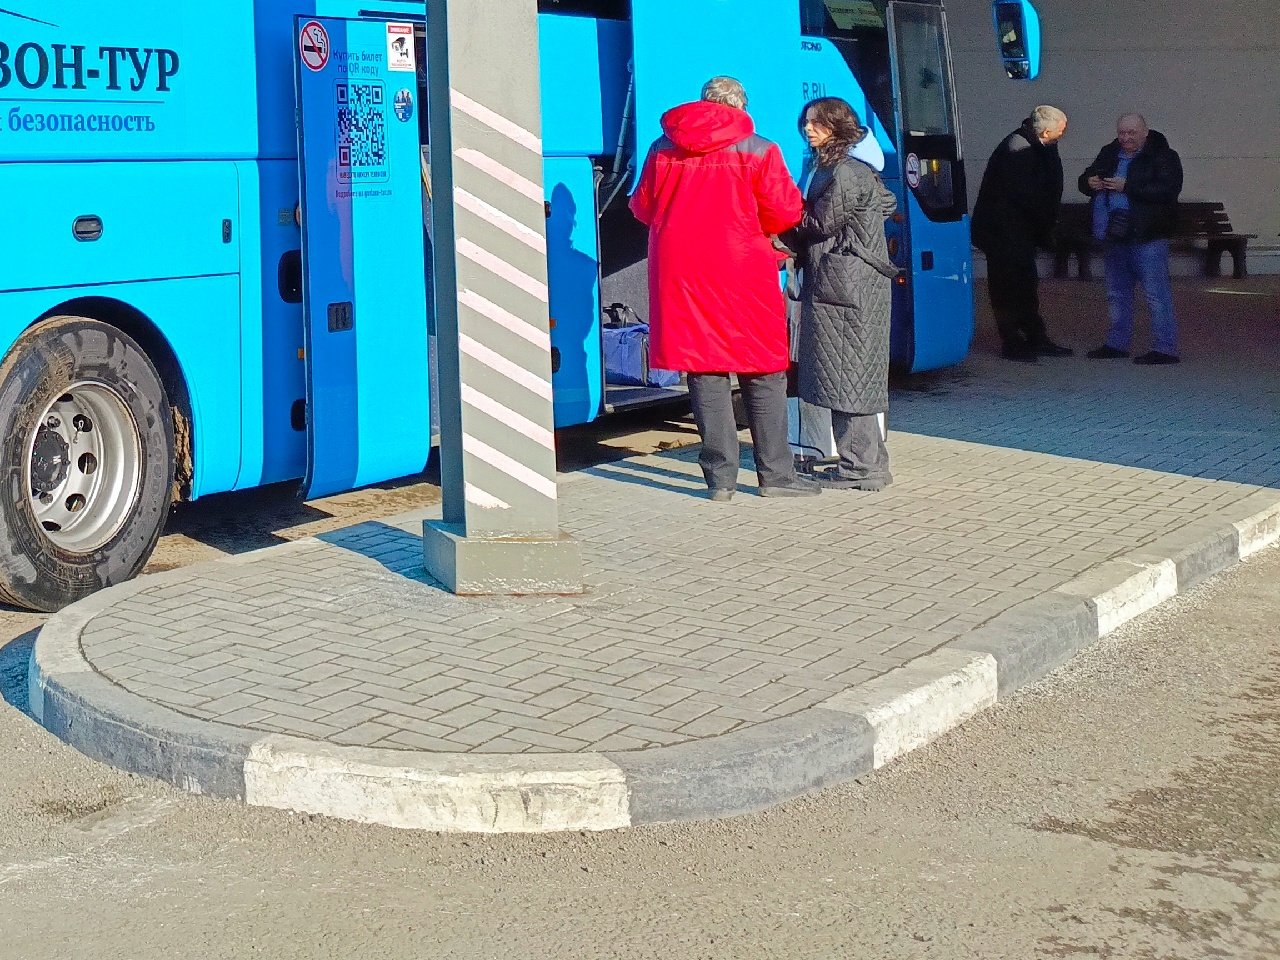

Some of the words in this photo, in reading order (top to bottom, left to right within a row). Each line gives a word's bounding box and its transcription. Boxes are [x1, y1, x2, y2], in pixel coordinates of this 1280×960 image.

[800, 41, 823, 52] TONG
[333, 49, 360, 62] Купить
[361, 50, 383, 62] билет
[337, 64, 348, 73] по
[349, 62, 360, 76] QR
[361, 65, 379, 77] коду
[8, 106, 155, 133] безопасность
